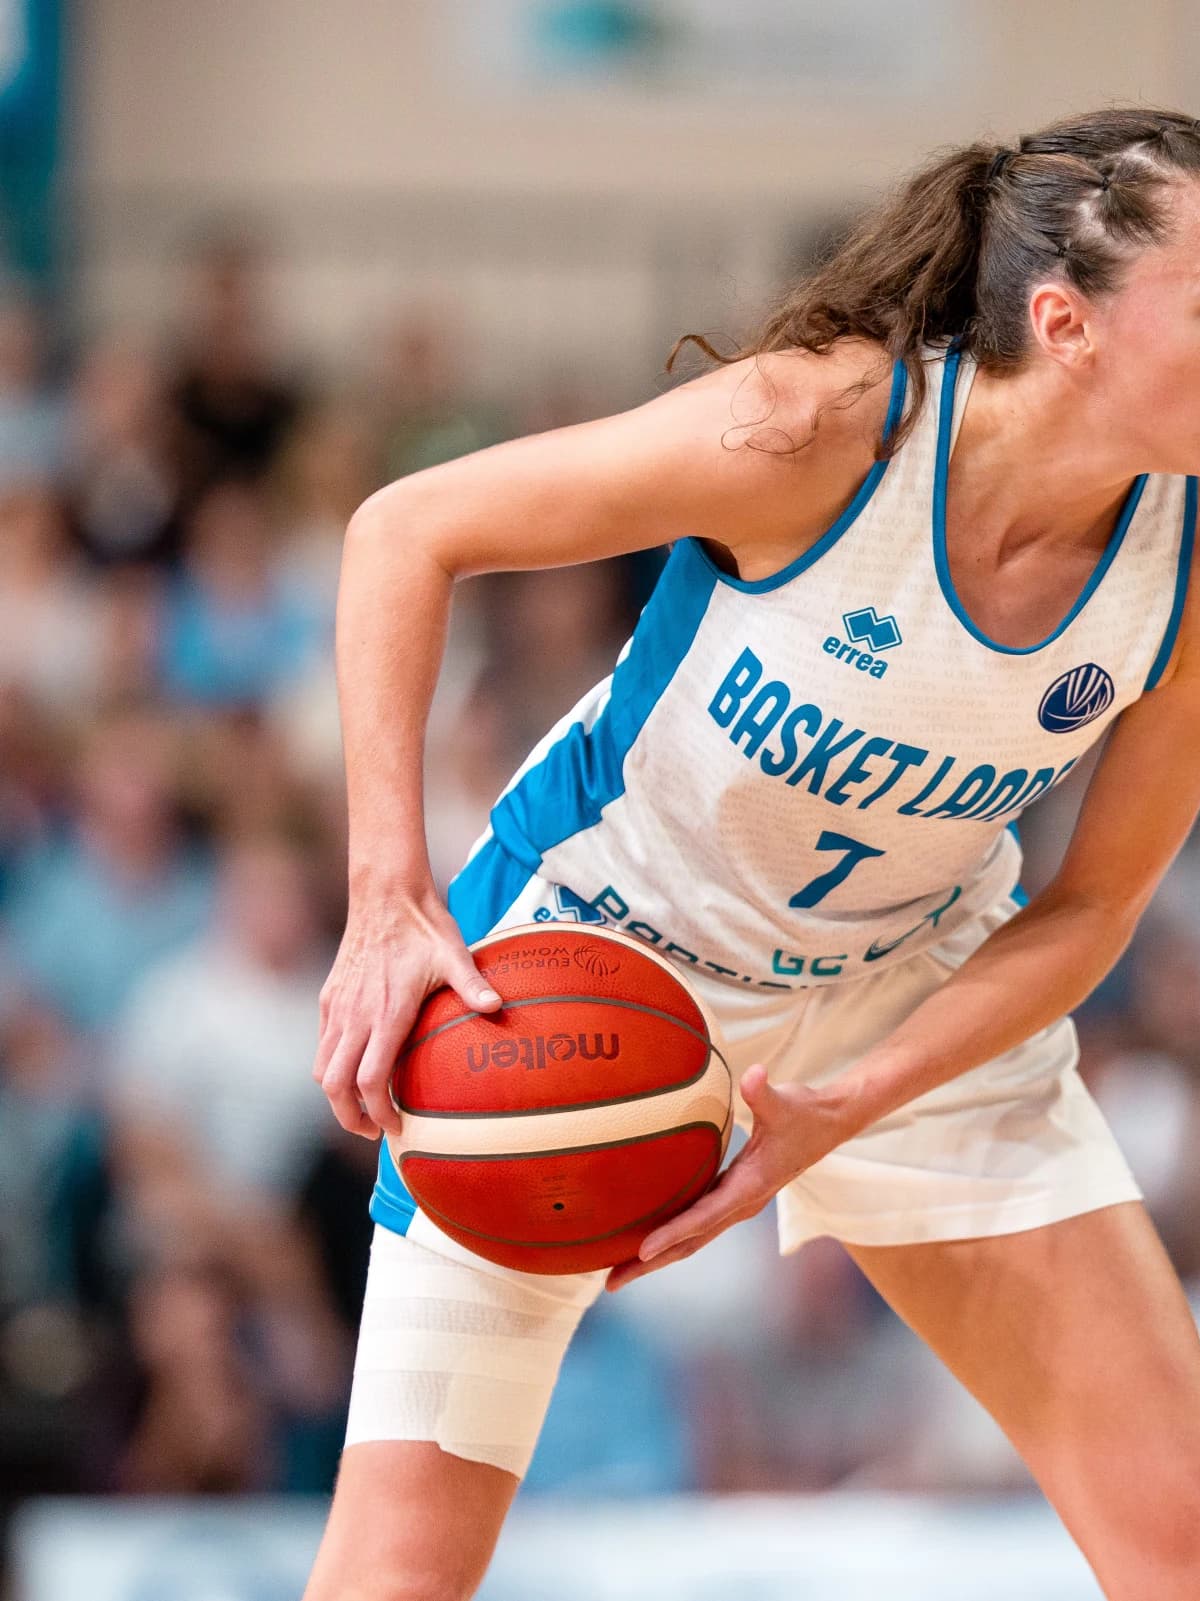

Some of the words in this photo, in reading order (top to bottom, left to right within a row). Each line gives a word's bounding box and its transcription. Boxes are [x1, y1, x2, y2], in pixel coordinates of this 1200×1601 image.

[822, 636, 888, 679] errea
[707, 646, 929, 810] BASKET
[897, 755, 1081, 822] LAND
[788, 830, 886, 909] 7
[480, 957, 570, 978] EUROLEAG
[498, 947, 569, 963] WOMEN
[467, 1033, 620, 1073] molten
